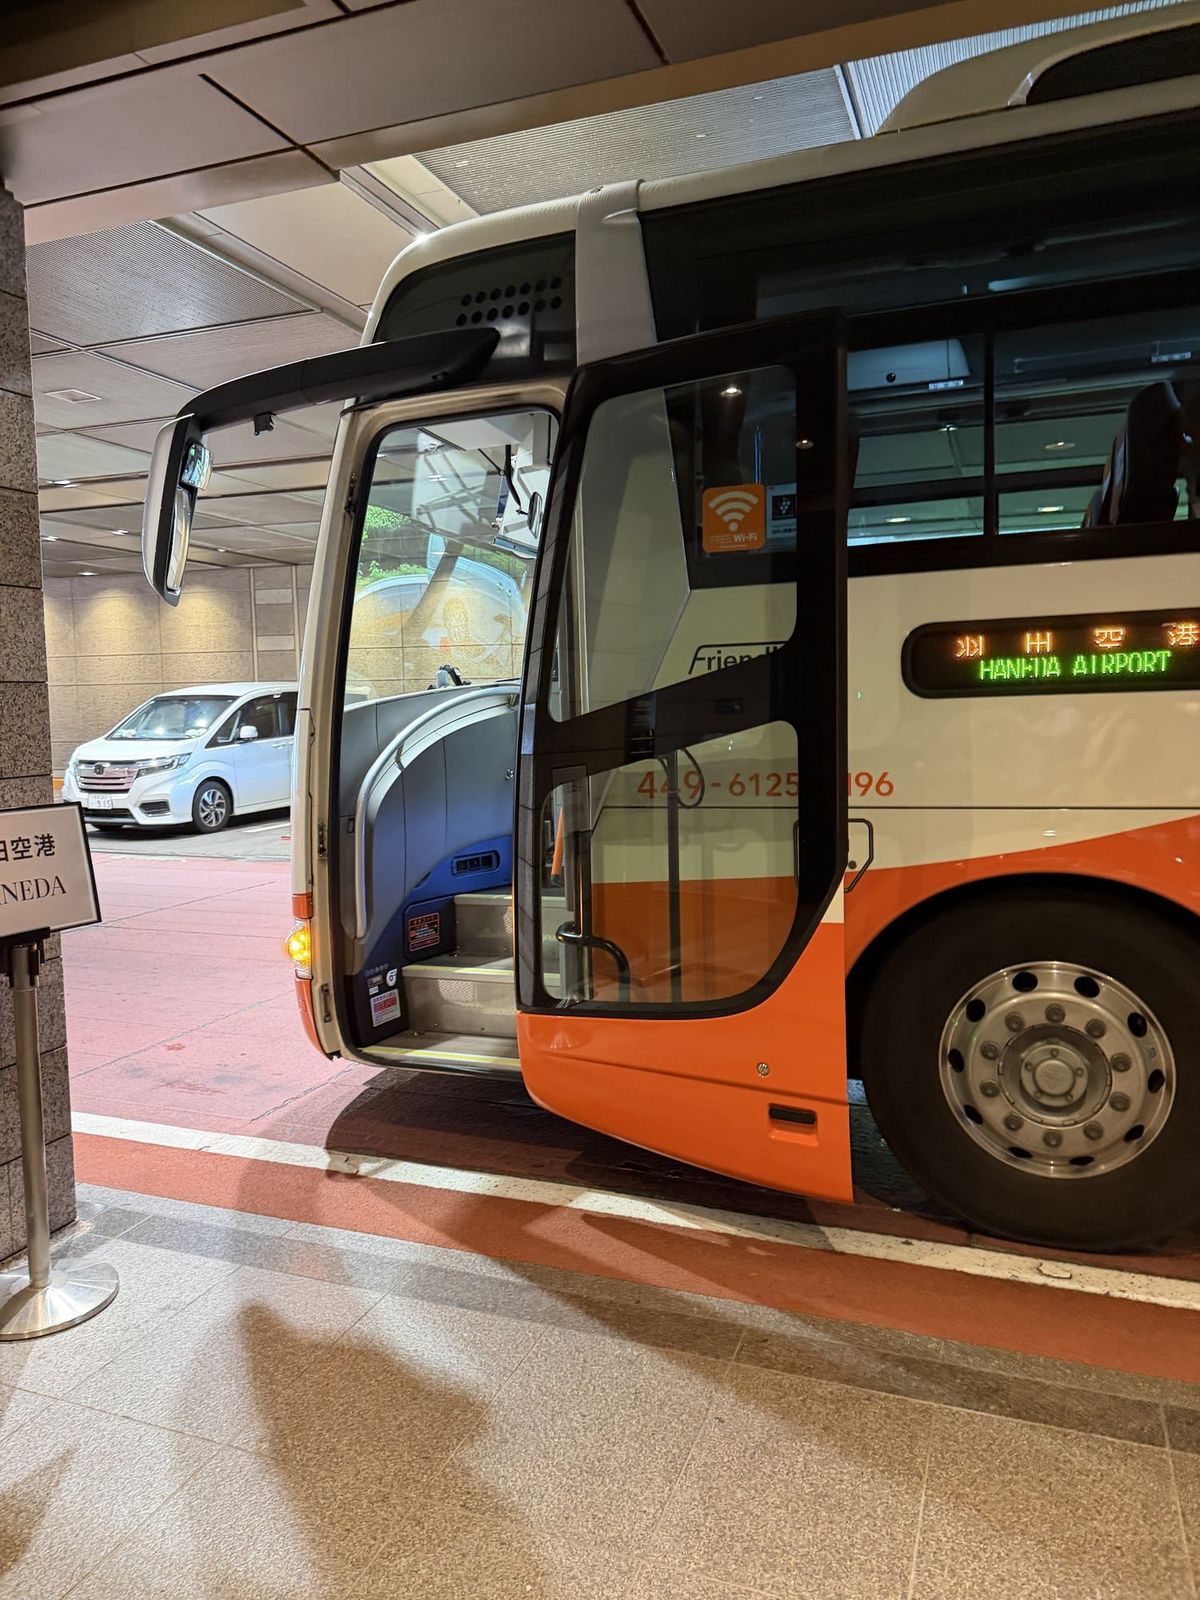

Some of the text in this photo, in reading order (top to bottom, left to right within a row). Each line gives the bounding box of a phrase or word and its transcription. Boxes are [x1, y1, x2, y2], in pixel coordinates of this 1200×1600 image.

[733, 532, 758, 543] Wi-Fi
[980, 650, 1171, 680] HANEDA AIRPORT
[0, 875, 68, 906] NEDA
